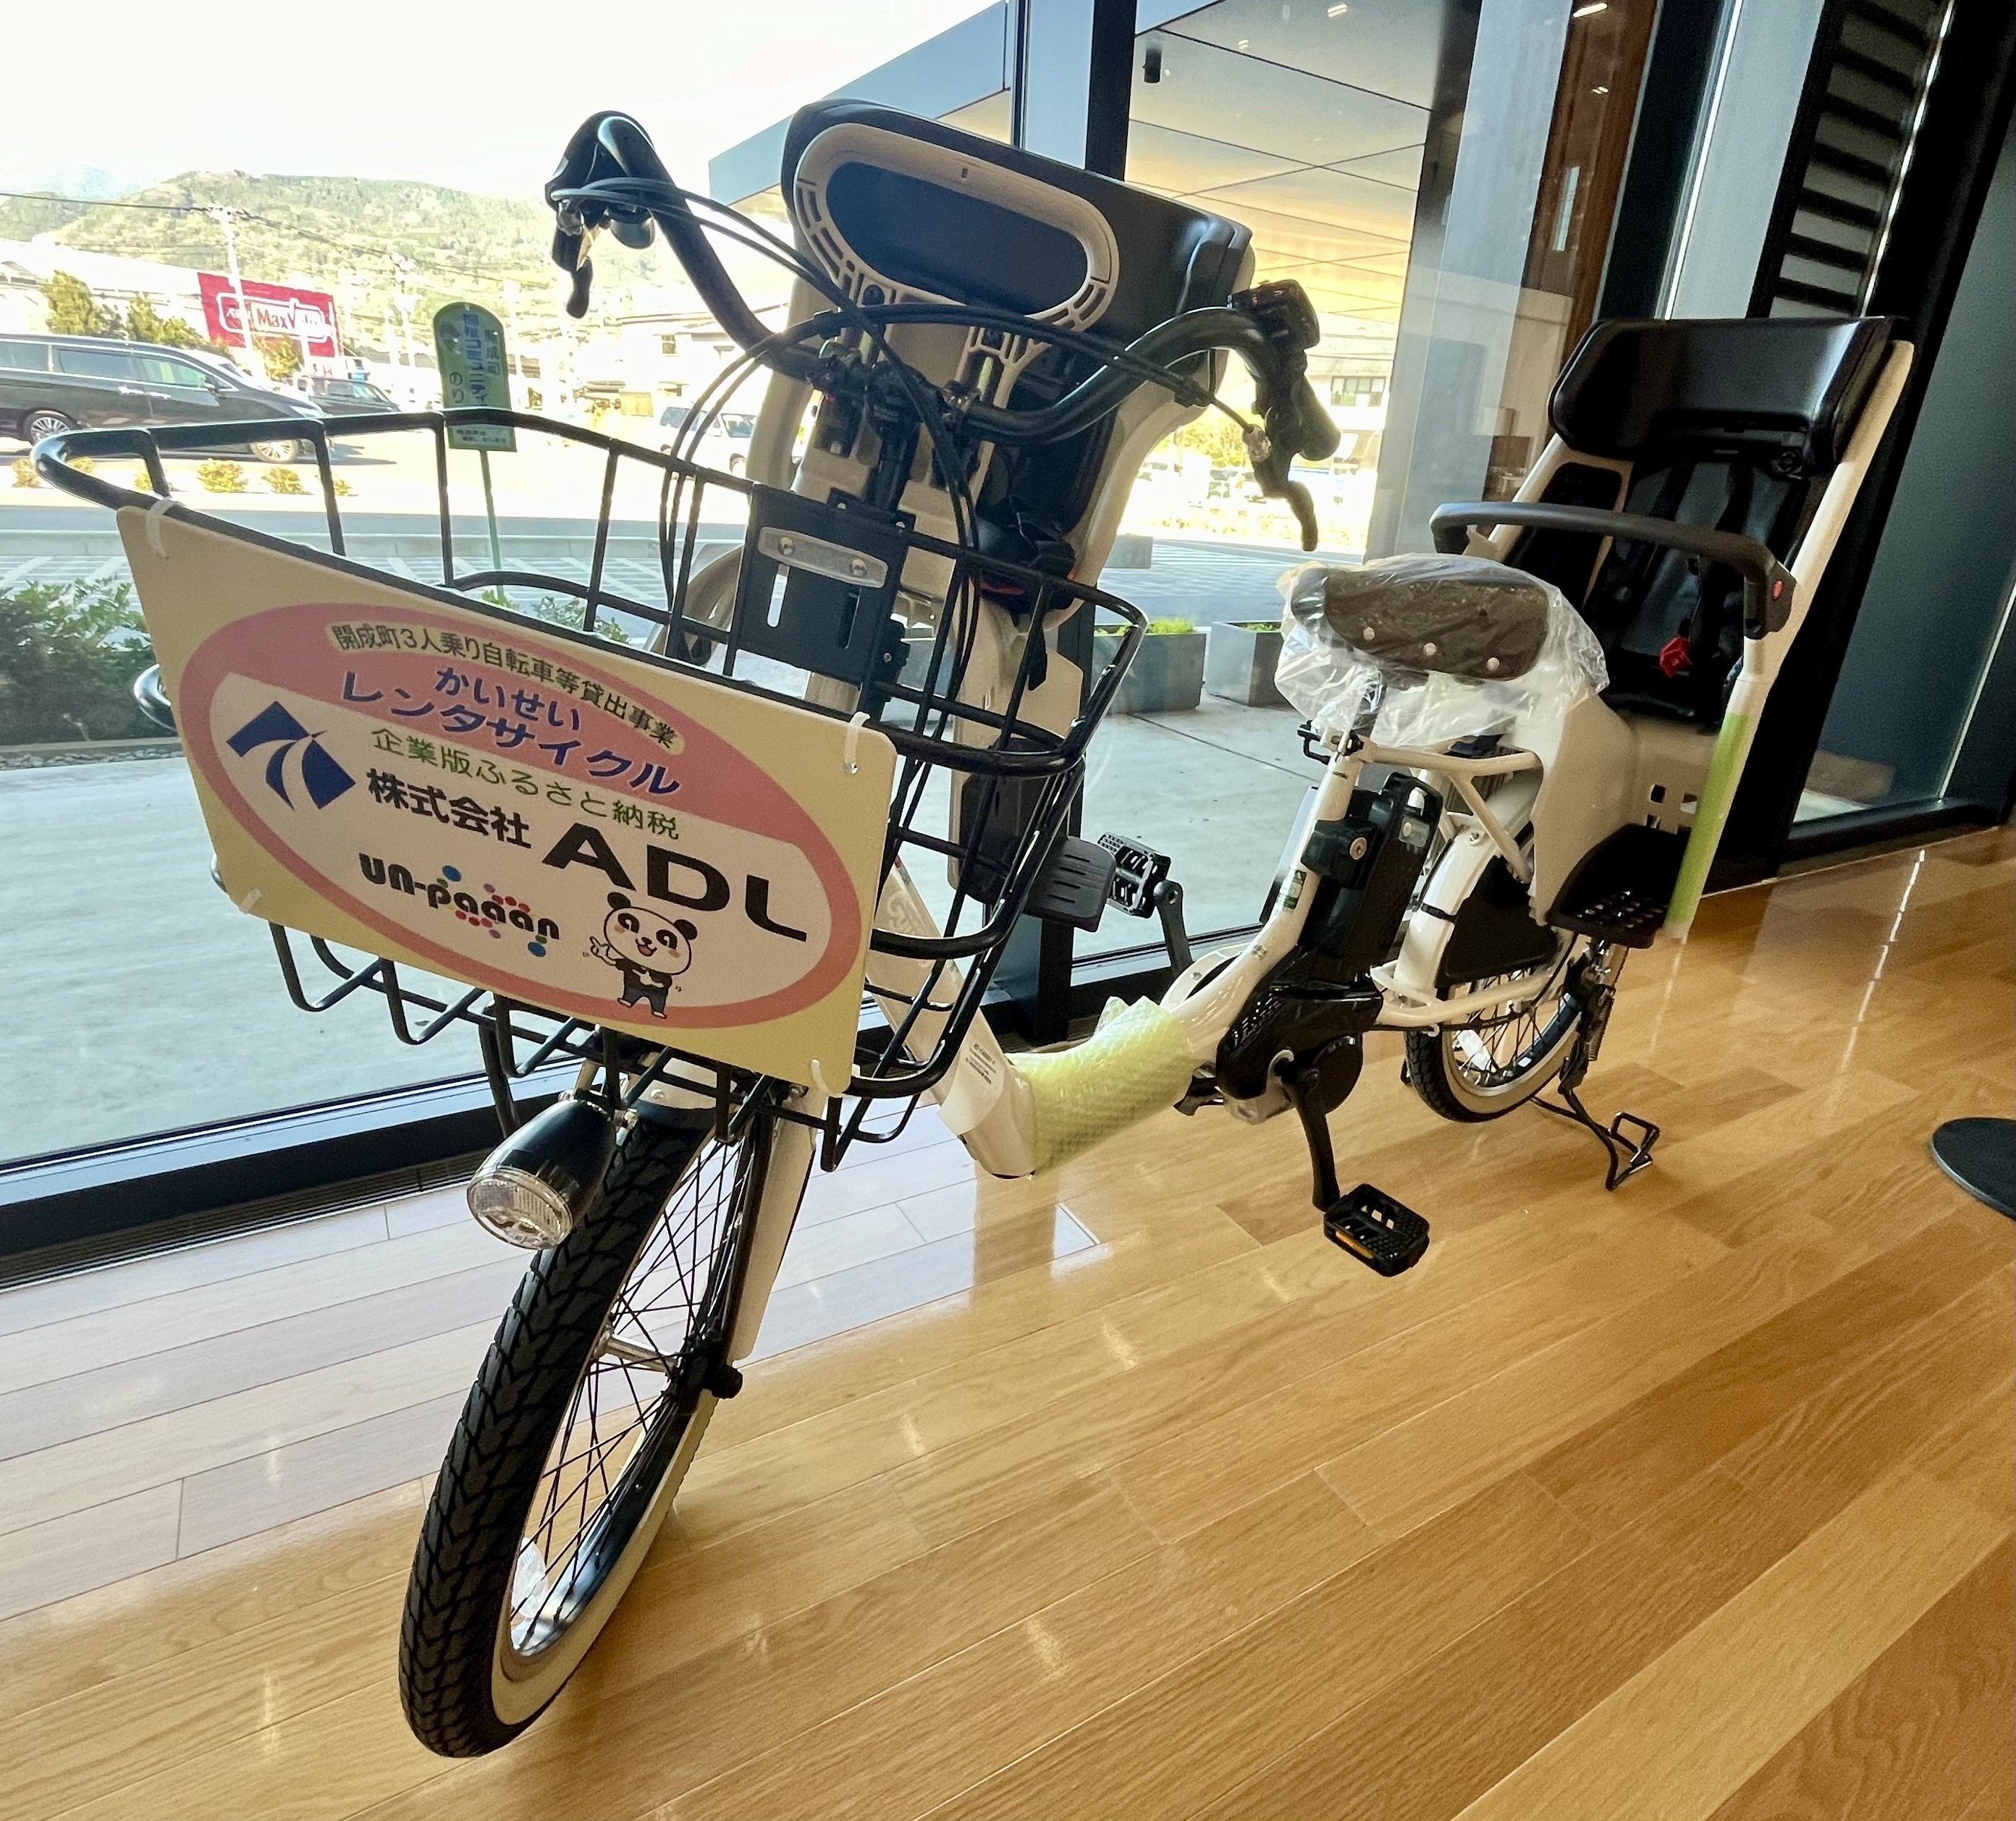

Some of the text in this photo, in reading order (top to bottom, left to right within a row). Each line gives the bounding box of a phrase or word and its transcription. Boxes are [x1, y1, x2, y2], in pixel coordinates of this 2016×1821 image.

[463, 313, 488, 406] 福祉コミュニティ
[332, 625, 675, 749] 開成町3人乗り自転車等貸出事業
[342, 671, 680, 794] レンタサイクル
[435, 667, 580, 731] かいせい
[372, 727, 679, 840] 企業版ふるさと納税
[358, 852, 560, 940] un-paaan
[366, 768, 532, 850] 株式会社
[541, 823, 807, 942] ADL
